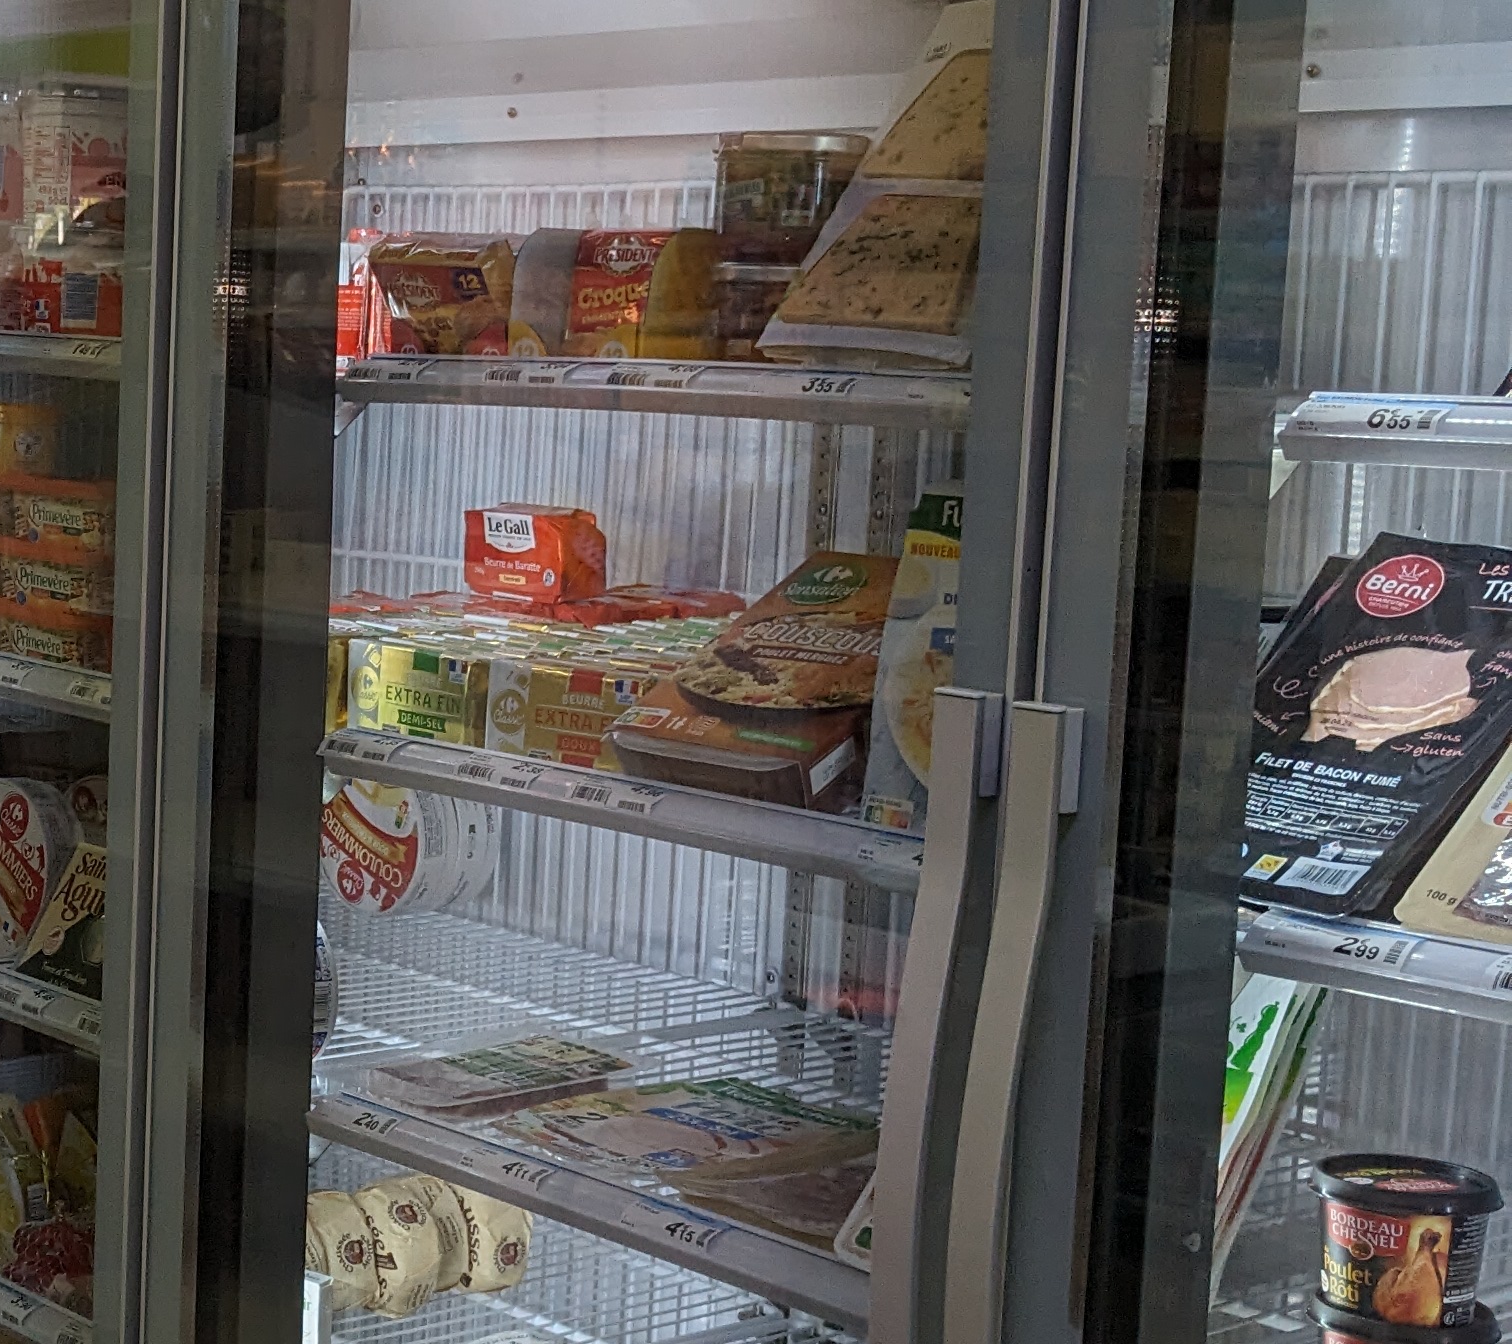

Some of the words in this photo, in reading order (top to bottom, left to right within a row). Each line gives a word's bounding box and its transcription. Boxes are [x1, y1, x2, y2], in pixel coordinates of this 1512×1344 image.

[457, 272, 481, 291] 12
[29, 503, 82, 527] Primevère
[487, 516, 503, 533] Le
[504, 518, 530, 536] Gall
[20, 568, 71, 591] Primevère
[1366, 573, 1434, 601] Berni
[16, 630, 62, 653] Primevère
[1345, 634, 1391, 653] histoire
[1394, 632, 1409, 643] de
[1409, 633, 1464, 650] confiance
[385, 684, 432, 709] EXTRA
[400, 710, 445, 732] DEMI-SEL
[535, 709, 599, 731] EXTRA
[1420, 731, 1461, 743] sans
[1412, 744, 1465, 757] gluten
[1255, 751, 1294, 769] FILET
[1293, 758, 1314, 772] DE
[1314, 764, 1363, 782] BACON
[1363, 774, 1402, 788] FUMÉ
[322, 807, 403, 888] COULOMMIERS
[1425, 888, 1446, 902] 100
[1448, 894, 1459, 906] g
[1332, 937, 1380, 960] 2€99
[1330, 1209, 1403, 1237] BORDEAU
[1332, 1223, 1399, 1250] CHESNEL
[1323, 1252, 1372, 1286] Poulet
[1329, 1274, 1360, 1302] Rôti
